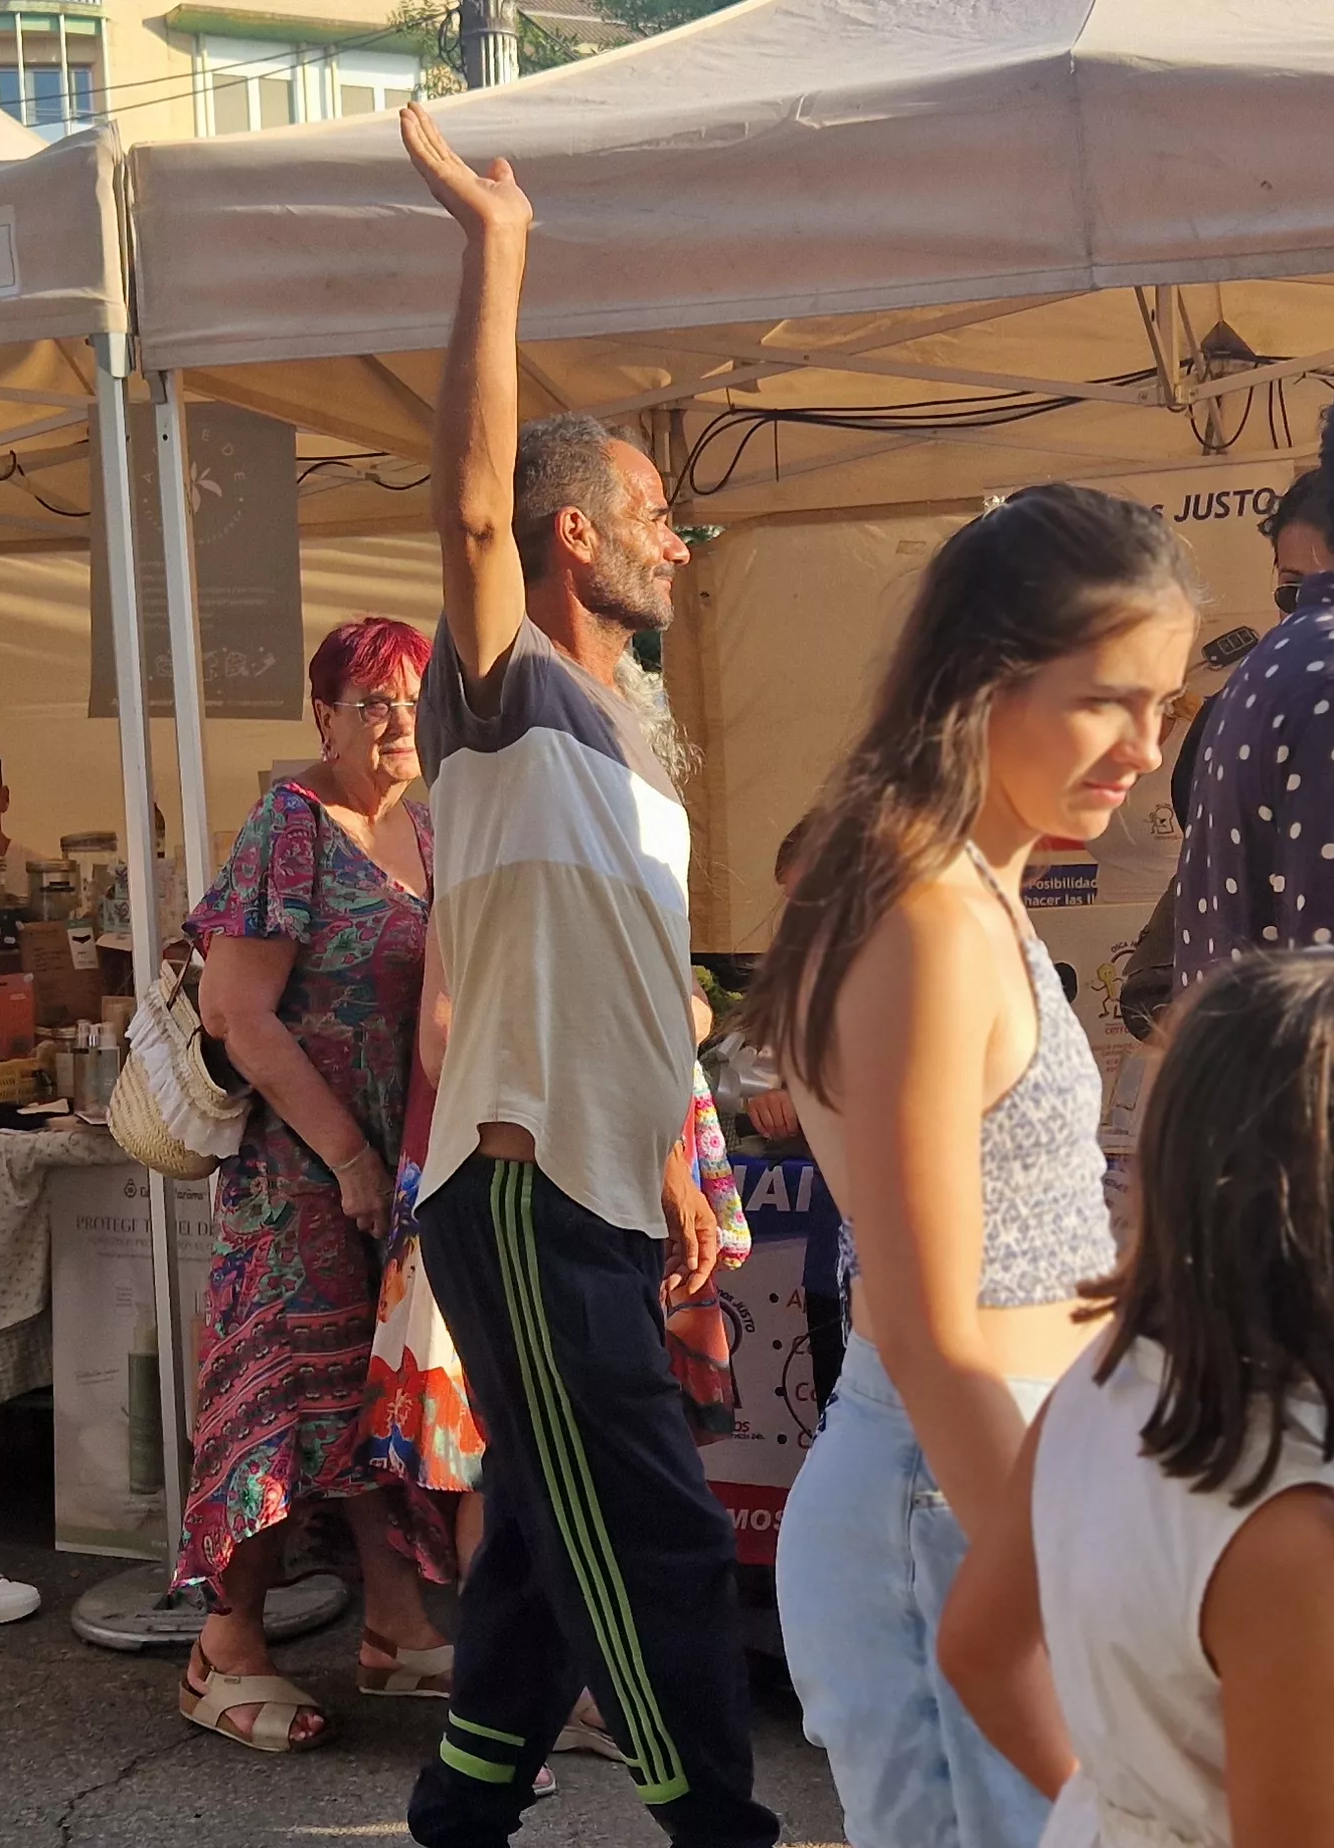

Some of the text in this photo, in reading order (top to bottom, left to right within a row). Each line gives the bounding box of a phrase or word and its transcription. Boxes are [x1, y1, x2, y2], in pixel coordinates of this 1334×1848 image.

[1174, 487, 1276, 522] JUSTO
[1024, 895, 1061, 906] hacer
[1065, 893, 1083, 906] las
[733, 1301, 756, 1333] JUSTO
